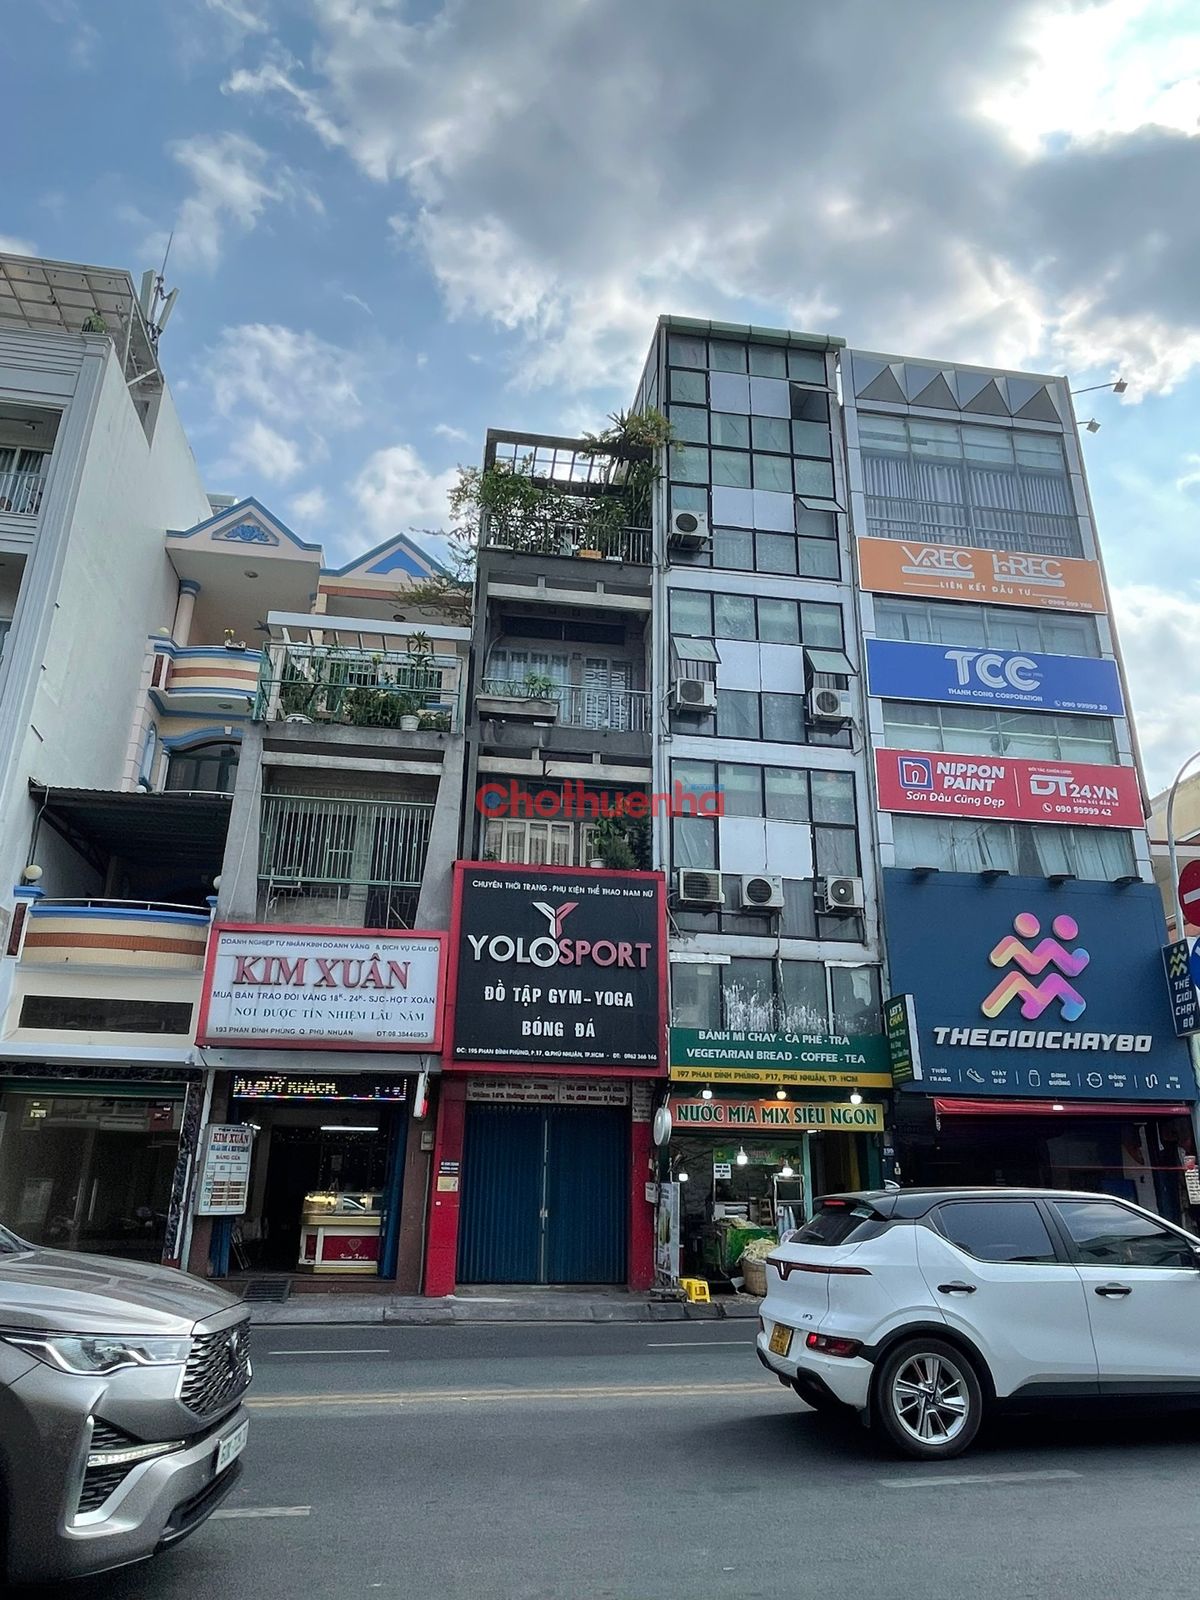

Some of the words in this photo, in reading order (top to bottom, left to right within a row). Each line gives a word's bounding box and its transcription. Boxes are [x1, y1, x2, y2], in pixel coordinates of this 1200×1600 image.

[901, 546, 973, 570] VREC
[944, 650, 1041, 692] TCC
[948, 688, 972, 696] THANH
[995, 692, 1042, 702] CORPORATION
[936, 762, 1004, 778] NIPPON
[944, 776, 996, 792] PAINT
[906, 790, 926, 800] Sơn
[930, 792, 952, 802] Đâu
[954, 794, 981, 807] Cũng
[984, 796, 1005, 808] Đẹp
[1073, 806, 1099, 815] 99999
[1101, 808, 1112, 816] 42
[472, 880, 502, 888] CHUYÊN
[505, 882, 520, 890] THỜI
[523, 884, 548, 892] TRANG
[552, 886, 566, 894] PHỤ
[568, 886, 585, 894] KIỆN
[602, 888, 620, 896] THAO
[350, 942, 370, 950] VÀNG
[232, 956, 308, 986] KIM
[314, 952, 411, 990] XUÂN
[1174, 975, 1190, 990] THẾ
[212, 990, 232, 998] MUA
[234, 990, 254, 998] BÁN
[257, 992, 282, 1000] TRAO
[302, 992, 326, 1002] VÀNG
[410, 996, 434, 1004] XOÀN
[484, 980, 506, 1001] ĐỒ
[513, 984, 542, 1006] TẬP
[549, 989, 582, 1004] GYM
[595, 991, 633, 1007] YOGA
[234, 1008, 257, 1016] NƠI
[302, 1008, 323, 1018] TÍN
[328, 1010, 366, 1022] NHIỆM
[371, 1009, 393, 1020] LÂU
[400, 1010, 424, 1021] NĂM
[1183, 1015, 1194, 1028] BỘ
[522, 1016, 564, 1036] BÓNG
[575, 1018, 596, 1037] ĐÁ
[698, 1029, 730, 1040] BÁNH
[732, 1030, 745, 1042] MÌ
[748, 1032, 776, 1042] CHAY
[802, 1033, 822, 1044] PHÊ
[828, 1034, 850, 1046] TRÀ
[932, 1026, 1152, 1053] THEGIOICHAYBO
[686, 1048, 754, 1060] VEGETARIAN
[756, 1050, 792, 1061] BREAD
[800, 1052, 838, 1062] COFFEE
[844, 1054, 866, 1064] TEA
[677, 1070, 690, 1078] 197
[677, 1102, 724, 1123] NƯỚC
[727, 1102, 758, 1124] MÍA
[760, 1106, 792, 1124] MIX
[794, 1102, 826, 1124] SIÊU
[830, 1108, 878, 1124] NGON
[213, 1133, 228, 1142] KIM
